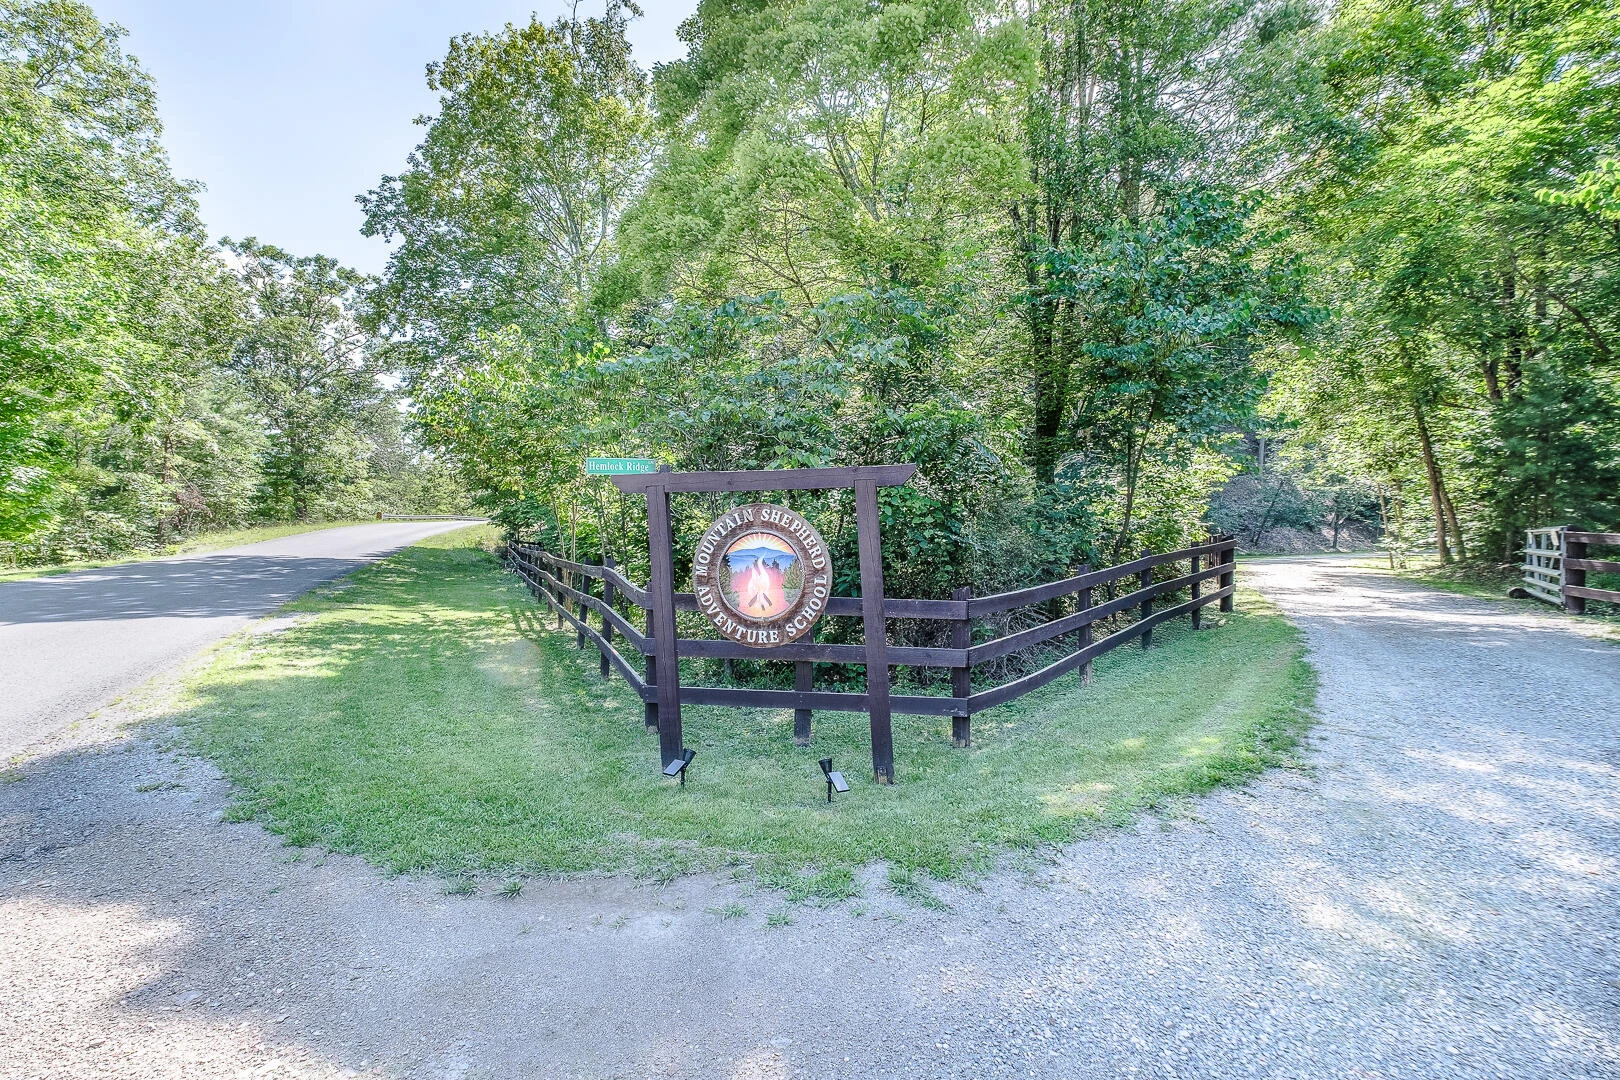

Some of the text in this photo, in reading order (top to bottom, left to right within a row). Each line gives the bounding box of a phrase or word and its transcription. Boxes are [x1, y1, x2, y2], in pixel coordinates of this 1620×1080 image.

[589, 461, 624, 471] Hemlock
[626, 462, 649, 473] Ridge
[695, 508, 826, 577] MOUNTAIN SHEPHERD
[697, 574, 828, 644] ADVENTURE SCHOOL
